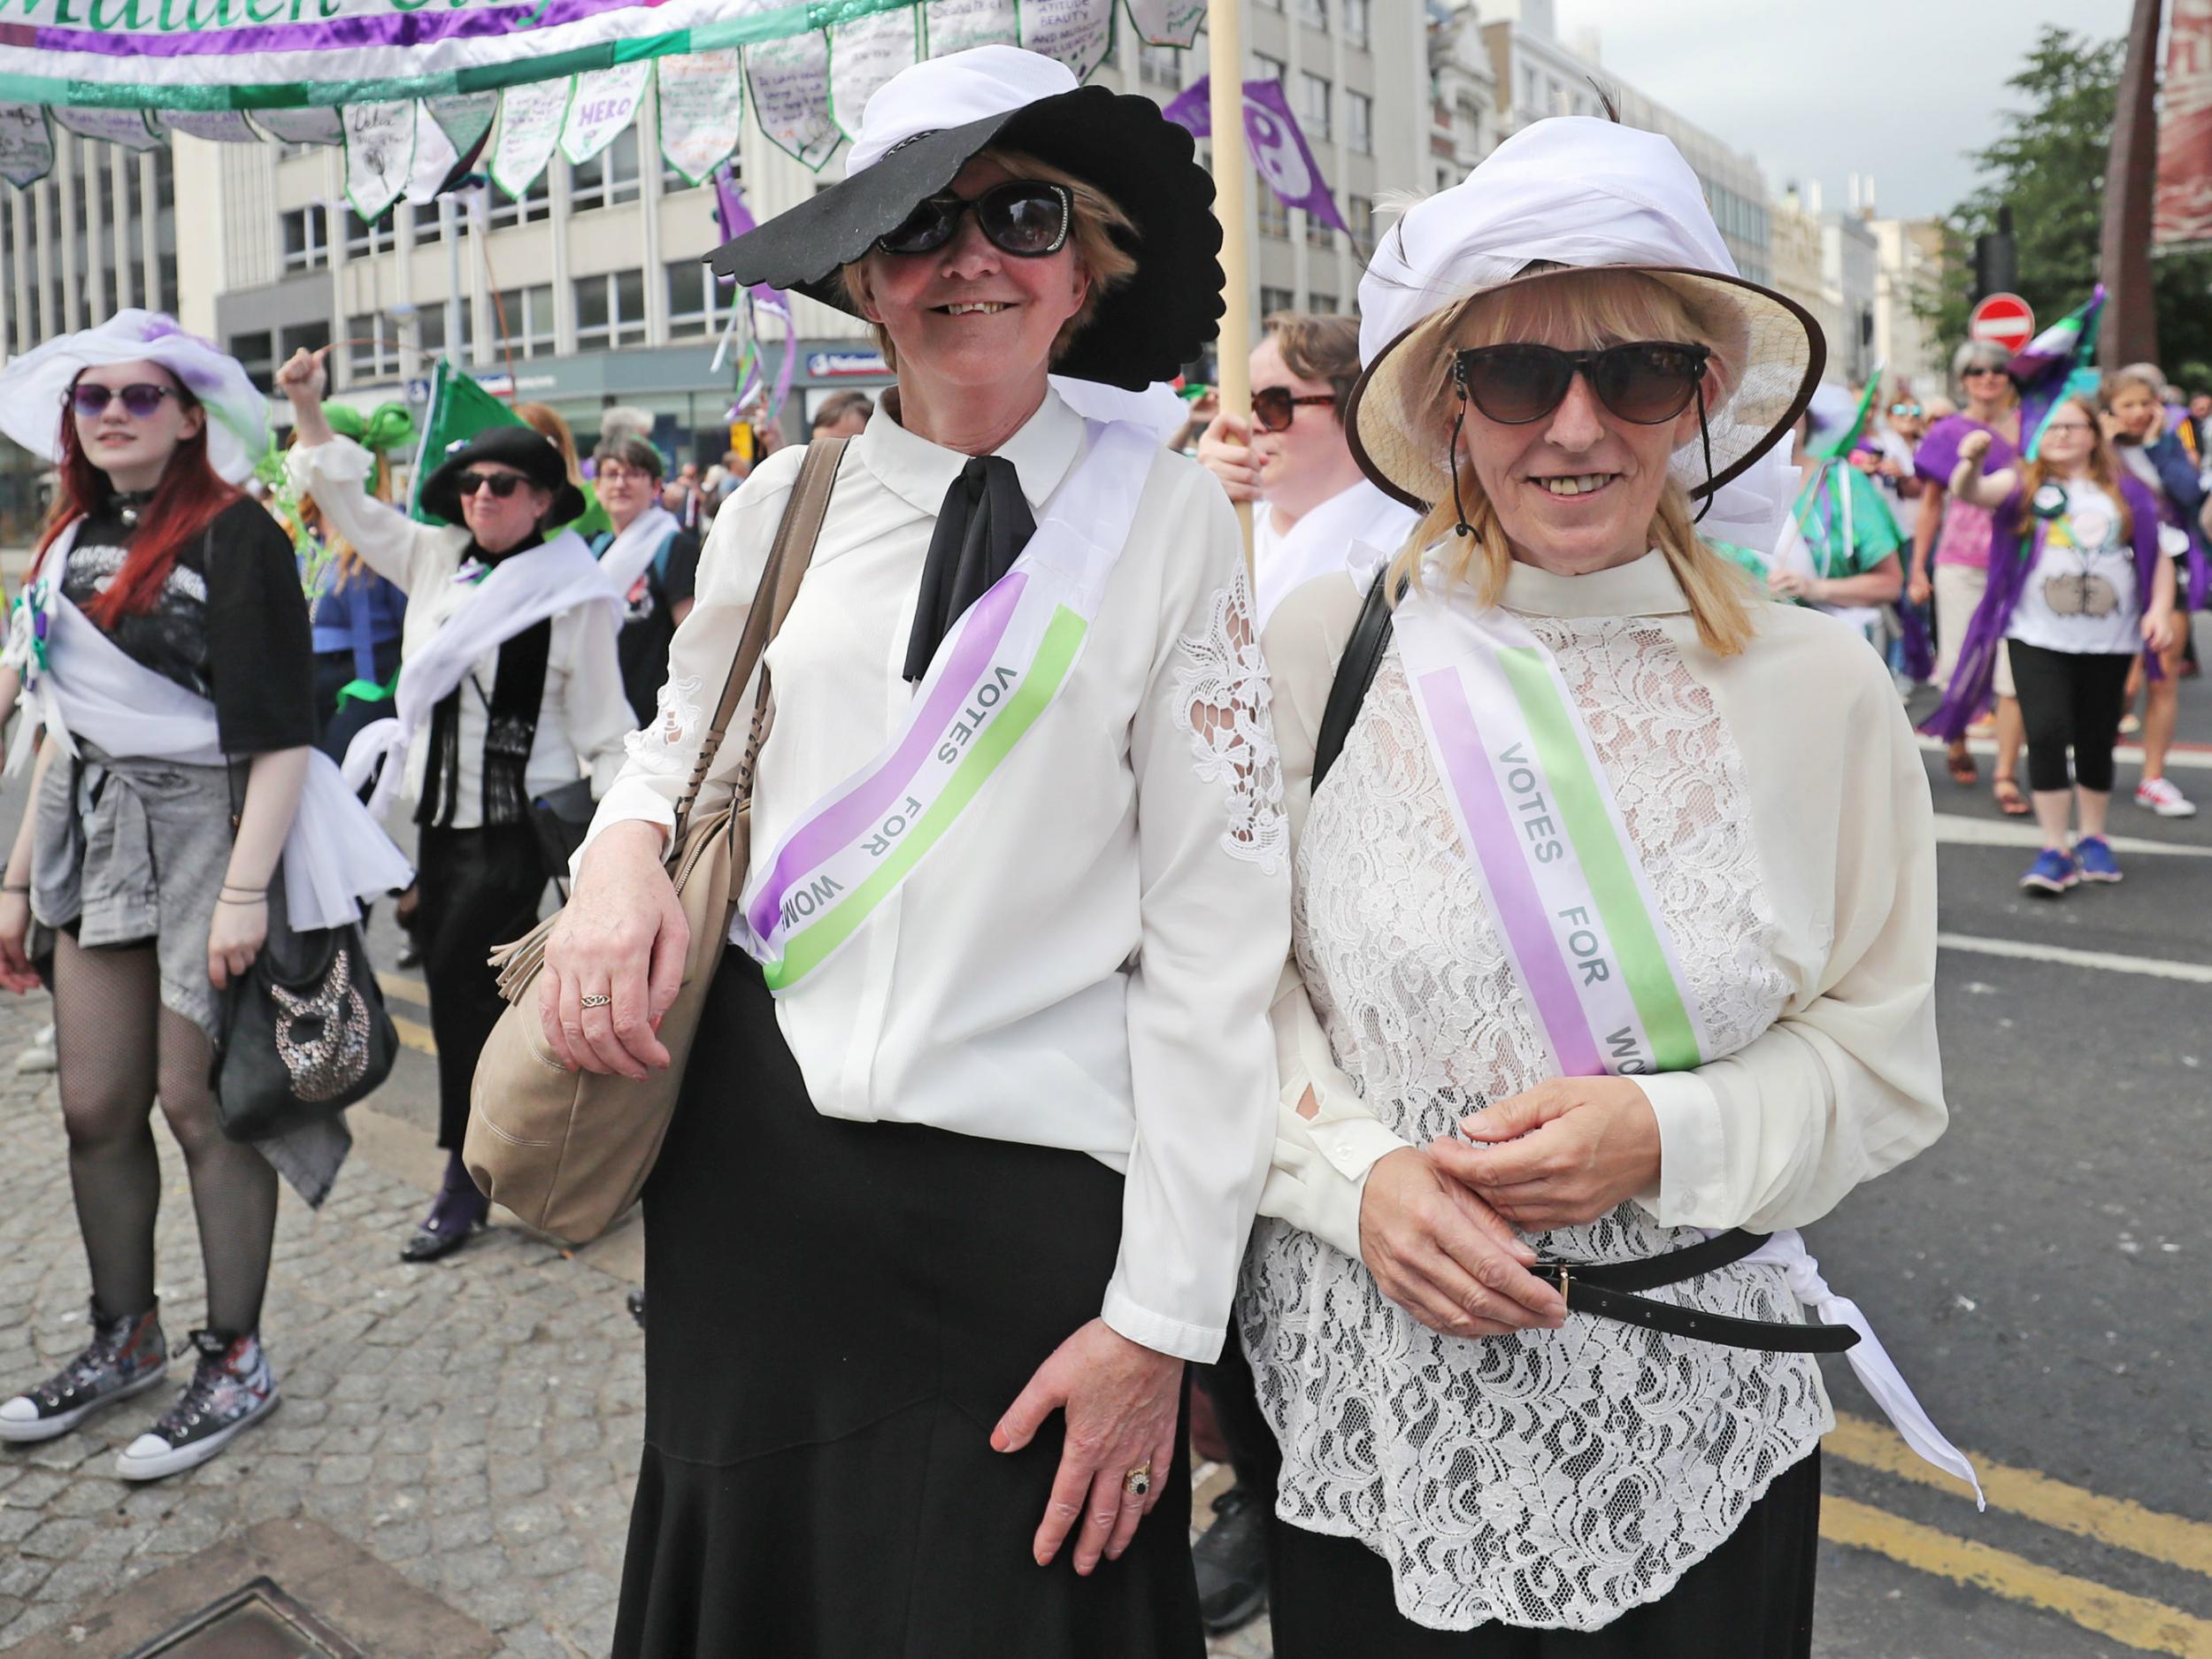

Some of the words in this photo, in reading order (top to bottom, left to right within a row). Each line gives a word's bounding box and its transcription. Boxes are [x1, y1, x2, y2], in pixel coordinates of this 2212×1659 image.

[578, 98, 631, 127] HERO
[936, 666, 1018, 764] VOTES
[860, 795, 922, 856] FOR
[780, 875, 845, 932] WOM
[1499, 741, 1563, 864] VOTES
[1557, 905, 1609, 987] FOR
[1605, 1025, 1647, 1074] WO
